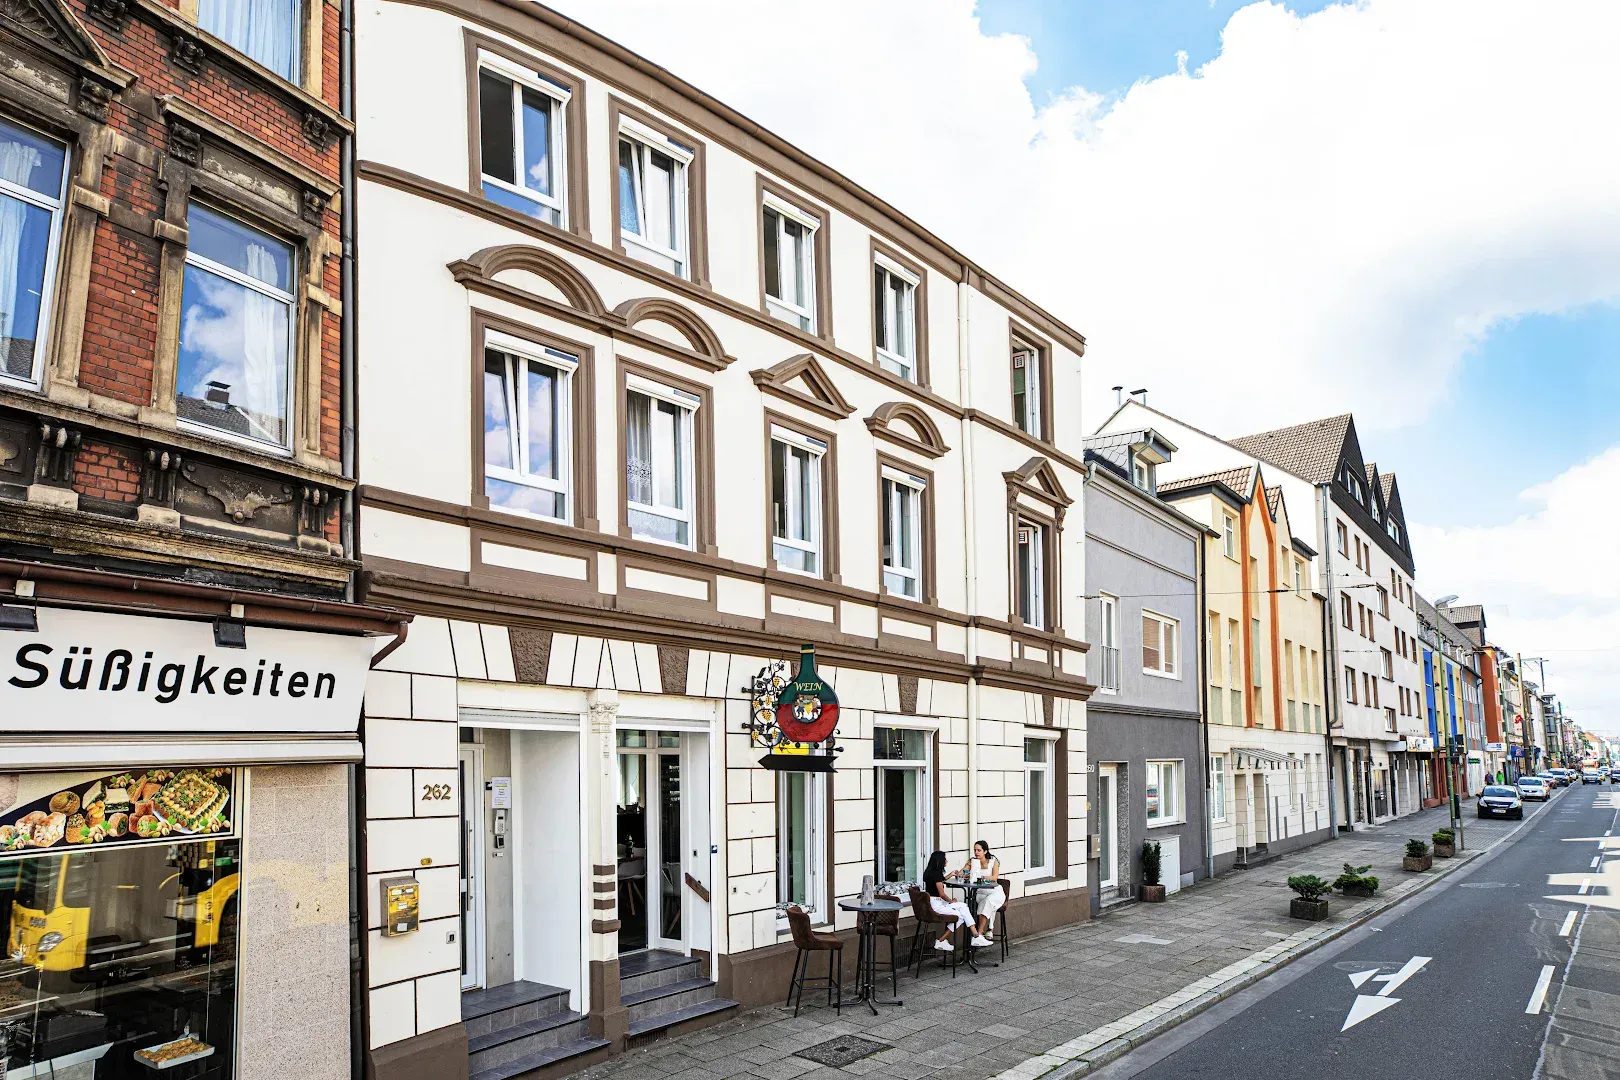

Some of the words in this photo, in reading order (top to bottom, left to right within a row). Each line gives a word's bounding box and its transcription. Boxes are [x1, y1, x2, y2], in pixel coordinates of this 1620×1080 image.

[7, 643, 336, 704] Süßigkeiten
[793, 682, 823, 691] WEIN
[421, 783, 452, 801] 262
